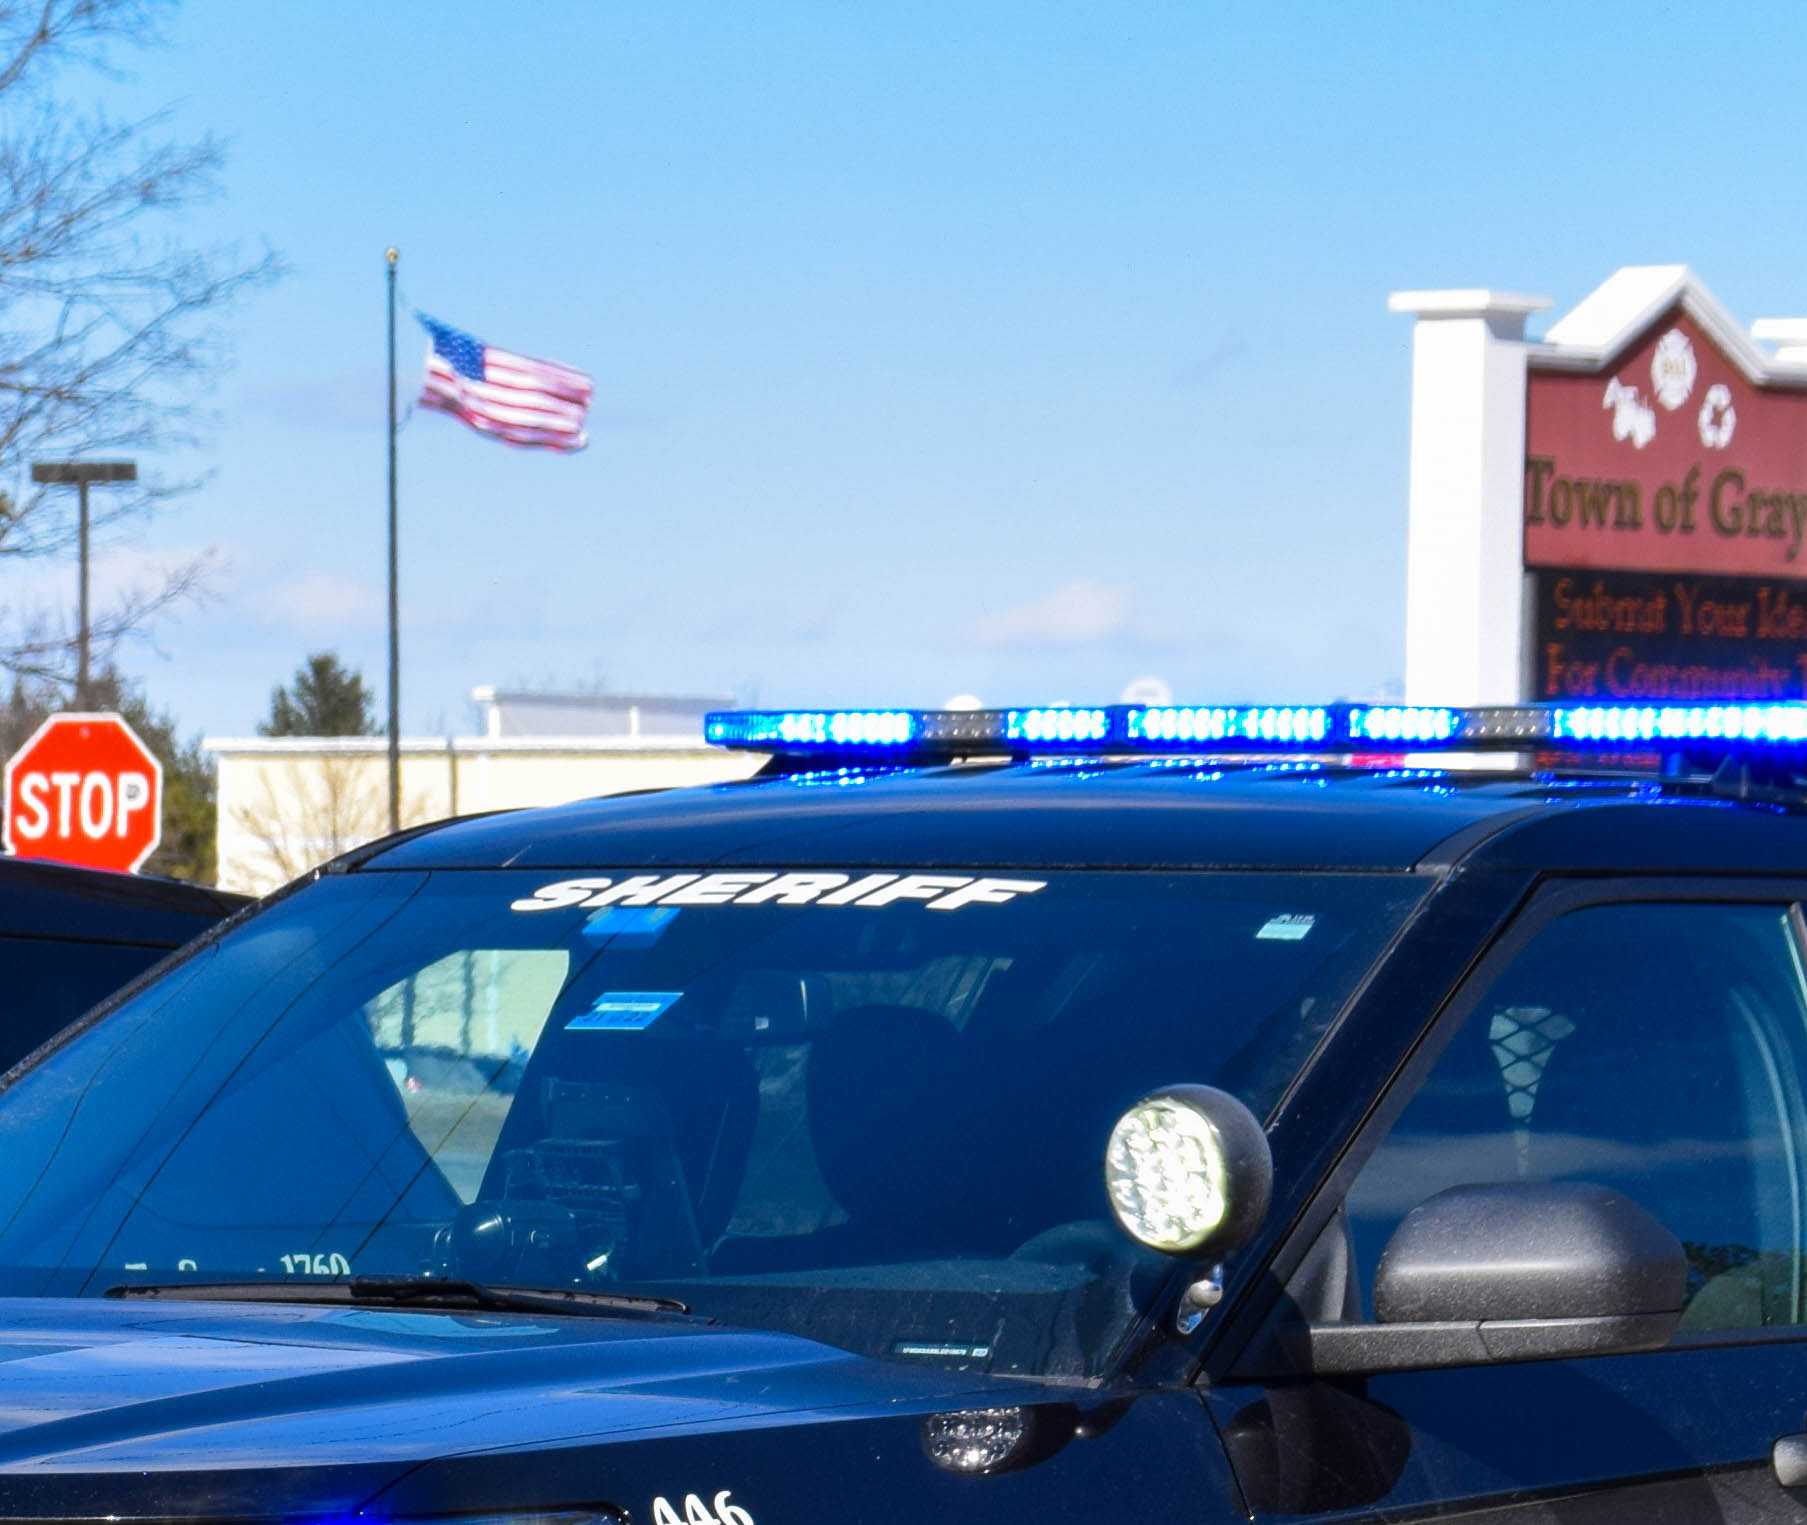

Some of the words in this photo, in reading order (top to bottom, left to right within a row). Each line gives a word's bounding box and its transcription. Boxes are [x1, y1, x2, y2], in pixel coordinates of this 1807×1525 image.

[1525, 456, 1643, 527] Town
[1653, 463, 1700, 533] of
[1553, 577, 1668, 633] Submit
[1674, 584, 1748, 637] Your
[1545, 643, 1598, 696] For
[1605, 647, 1790, 699] Community
[16, 771, 150, 839] STOP
[510, 873, 1048, 911] SHERIFF
